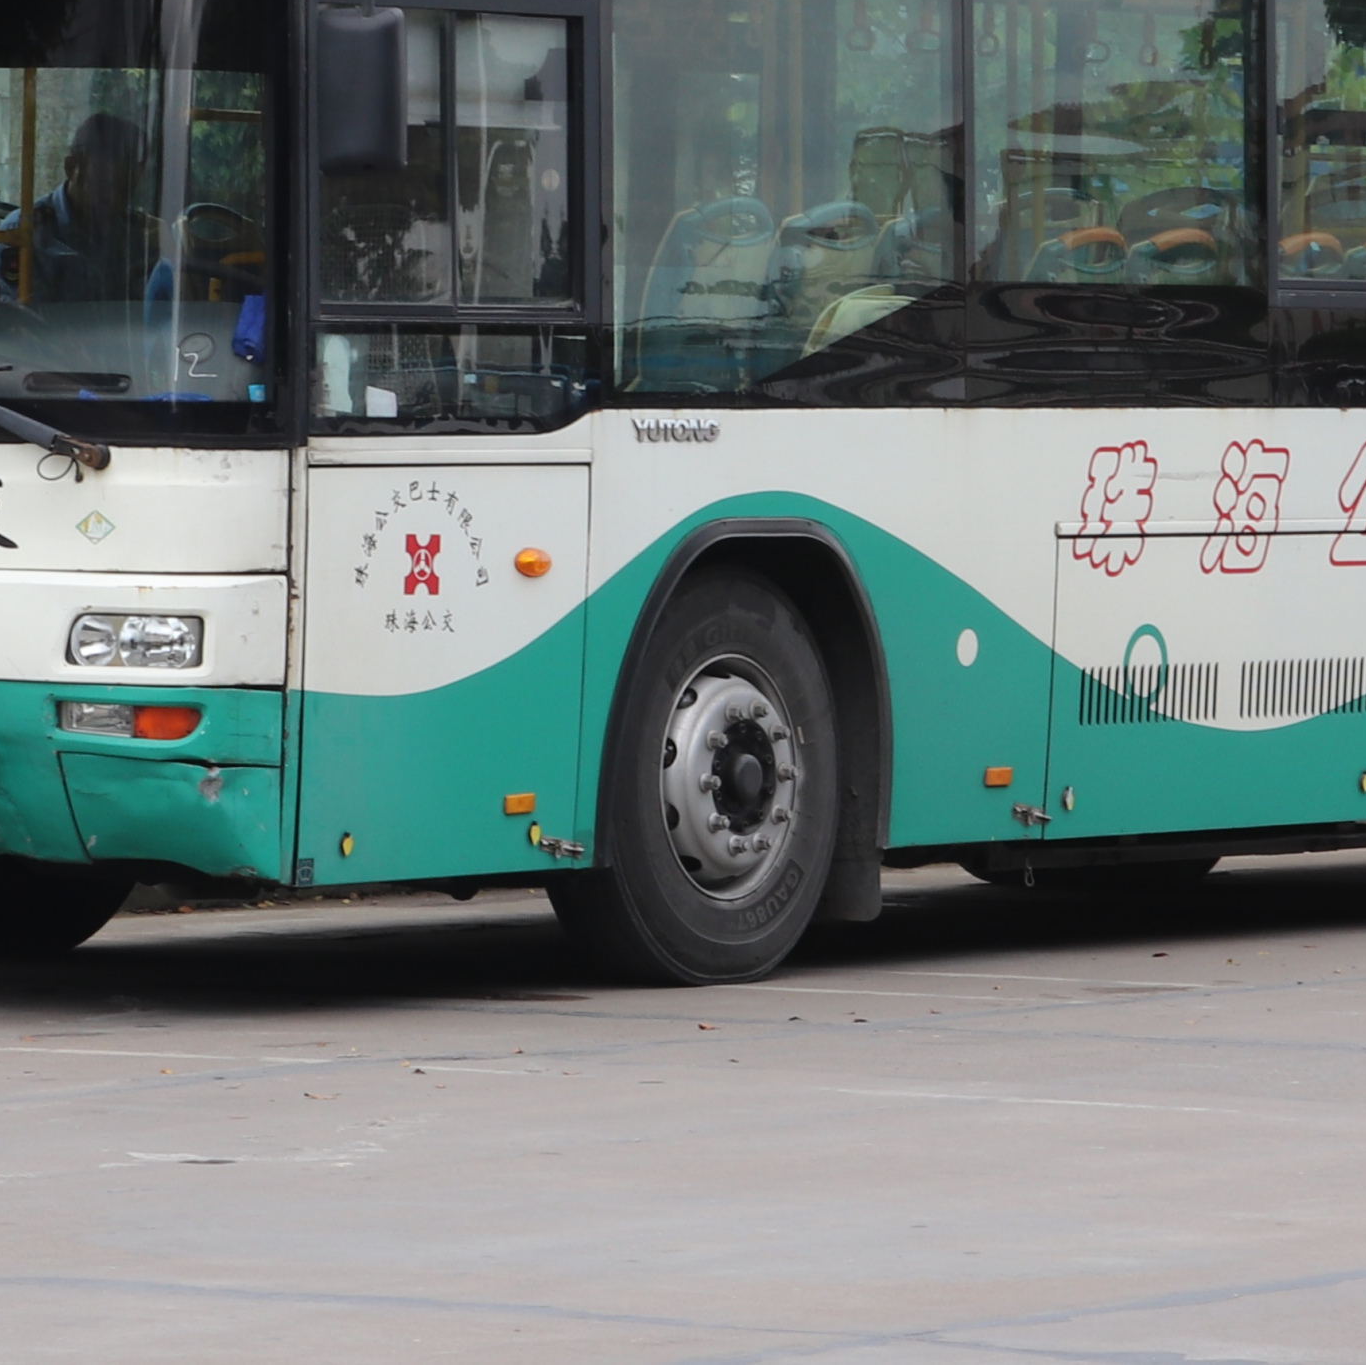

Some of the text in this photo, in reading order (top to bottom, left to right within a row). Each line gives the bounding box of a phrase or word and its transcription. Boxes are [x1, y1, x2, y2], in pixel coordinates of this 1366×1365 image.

[630, 418, 721, 443] YUTONG
[385, 608, 455, 634] 珠海公交
